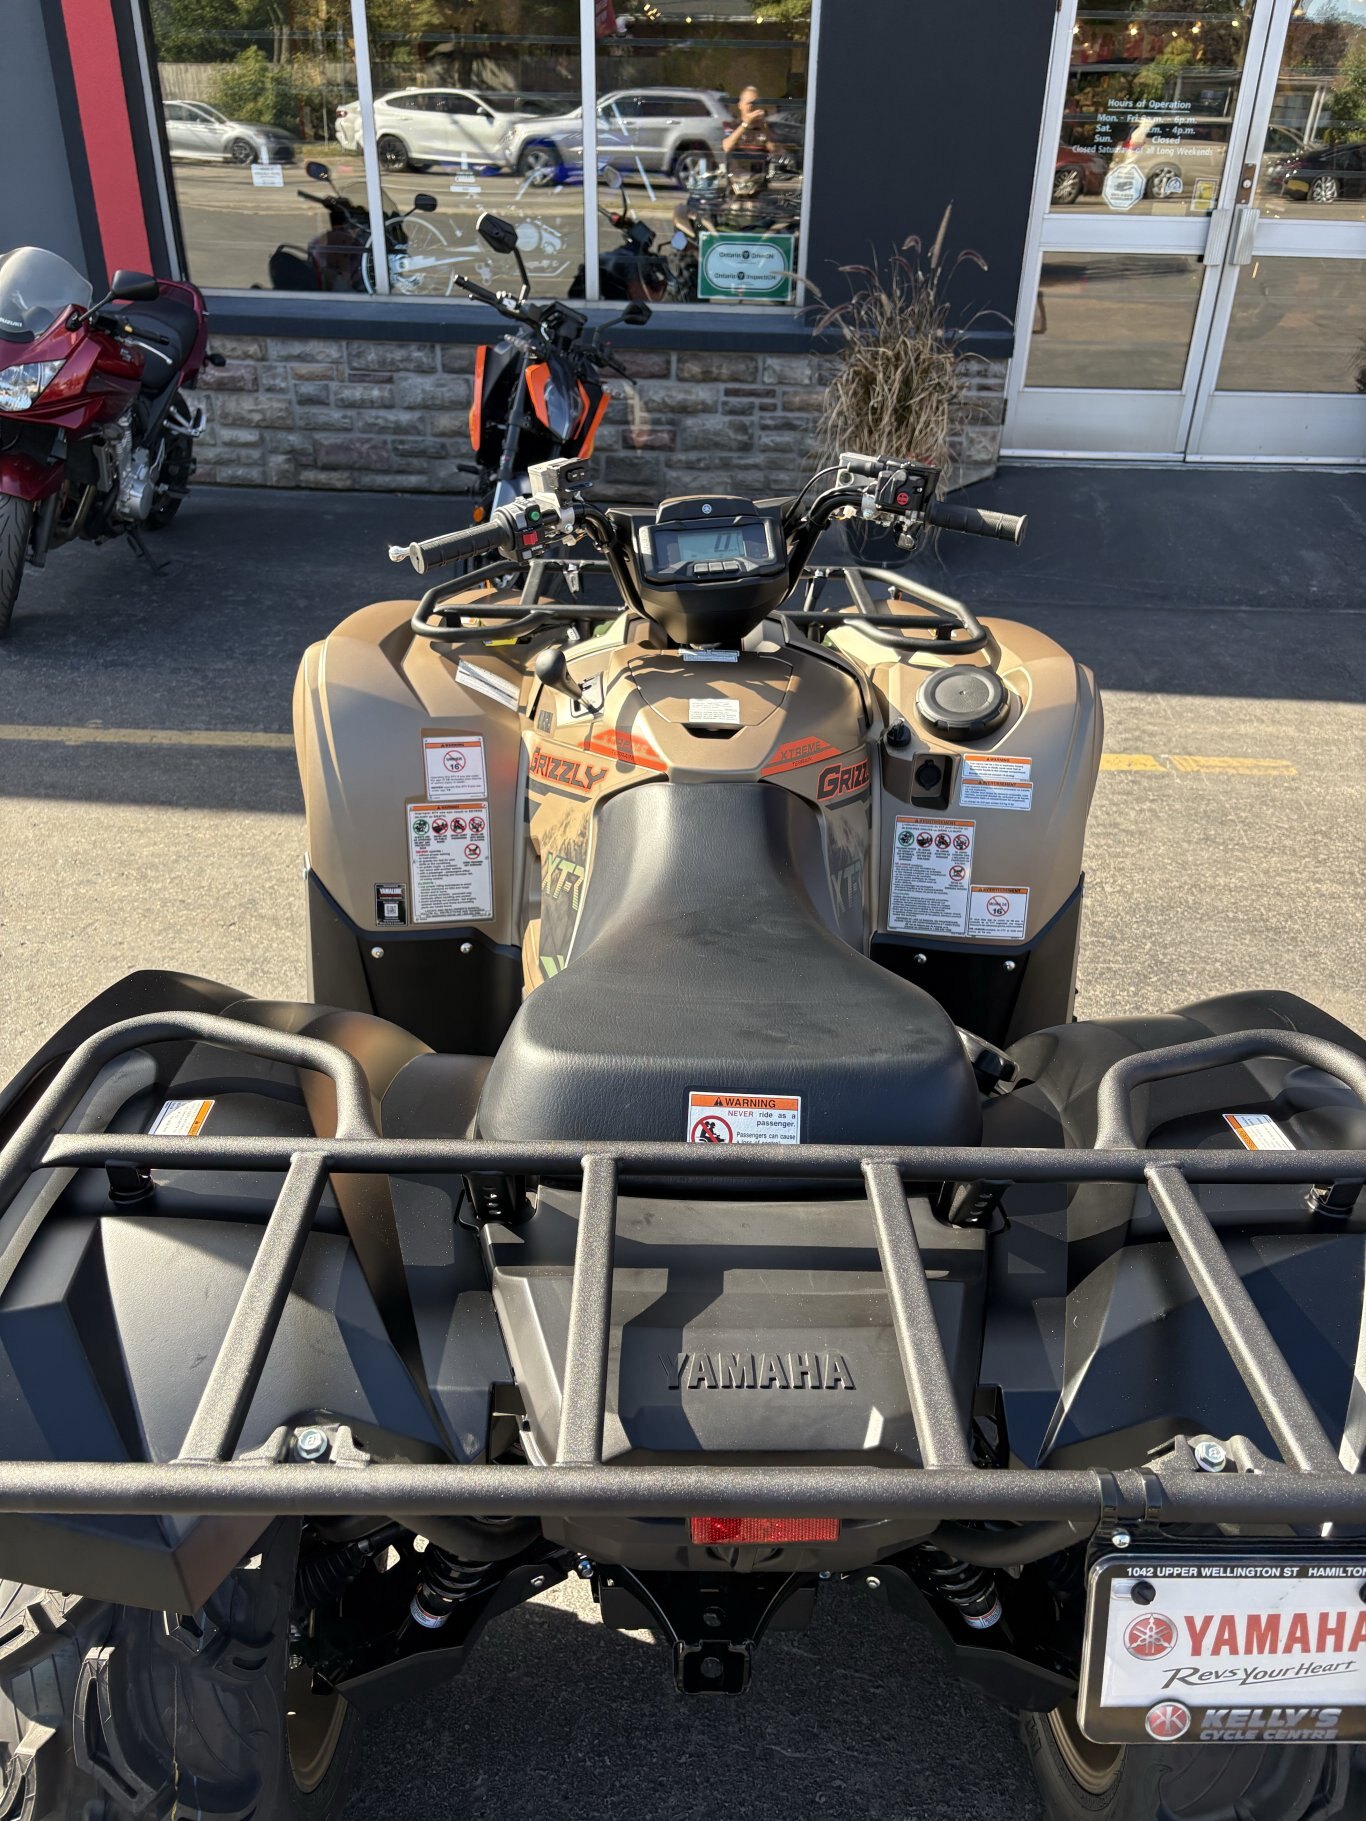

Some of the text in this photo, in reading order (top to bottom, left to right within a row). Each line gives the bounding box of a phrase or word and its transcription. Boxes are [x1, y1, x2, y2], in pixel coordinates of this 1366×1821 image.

[1107, 99, 1192, 110] Hours of Operation
[1096, 113, 1119, 123] Mon.
[1173, 115, 1198, 125] 6p.m.
[1095, 124, 1112, 133] Sat.
[1172, 126, 1196, 135] 4p.m.
[1094, 134, 1181, 145] Sun. Closed
[1072, 145, 1096, 154] Closed
[1156, 147, 1175, 157] Long
[1176, 147, 1214, 157] Weekends
[780, 741, 821, 761] XTREME
[529, 746, 608, 791] GRIZZLY
[816, 760, 870, 800] GRIZZ
[725, 1097, 776, 1108] WARNING
[759, 1111, 774, 1119] ride
[756, 1120, 796, 1128] passenger.
[736, 1131, 767, 1140] Passengers
[657, 1352, 857, 1391] YAMAHA
[1126, 1567, 1154, 1577] 1042
[1156, 1567, 1198, 1577] UPPER
[1200, 1567, 1281, 1577] WELLINGTON
[1282, 1567, 1300, 1577] ST
[1183, 1610, 1366, 1657] YAMAHA
[1161, 1660, 1358, 1690] Revs Your Heart
[1200, 1708, 1342, 1729] KELLY'S
[1199, 1729, 1339, 1741] CYCLE CENTRE
